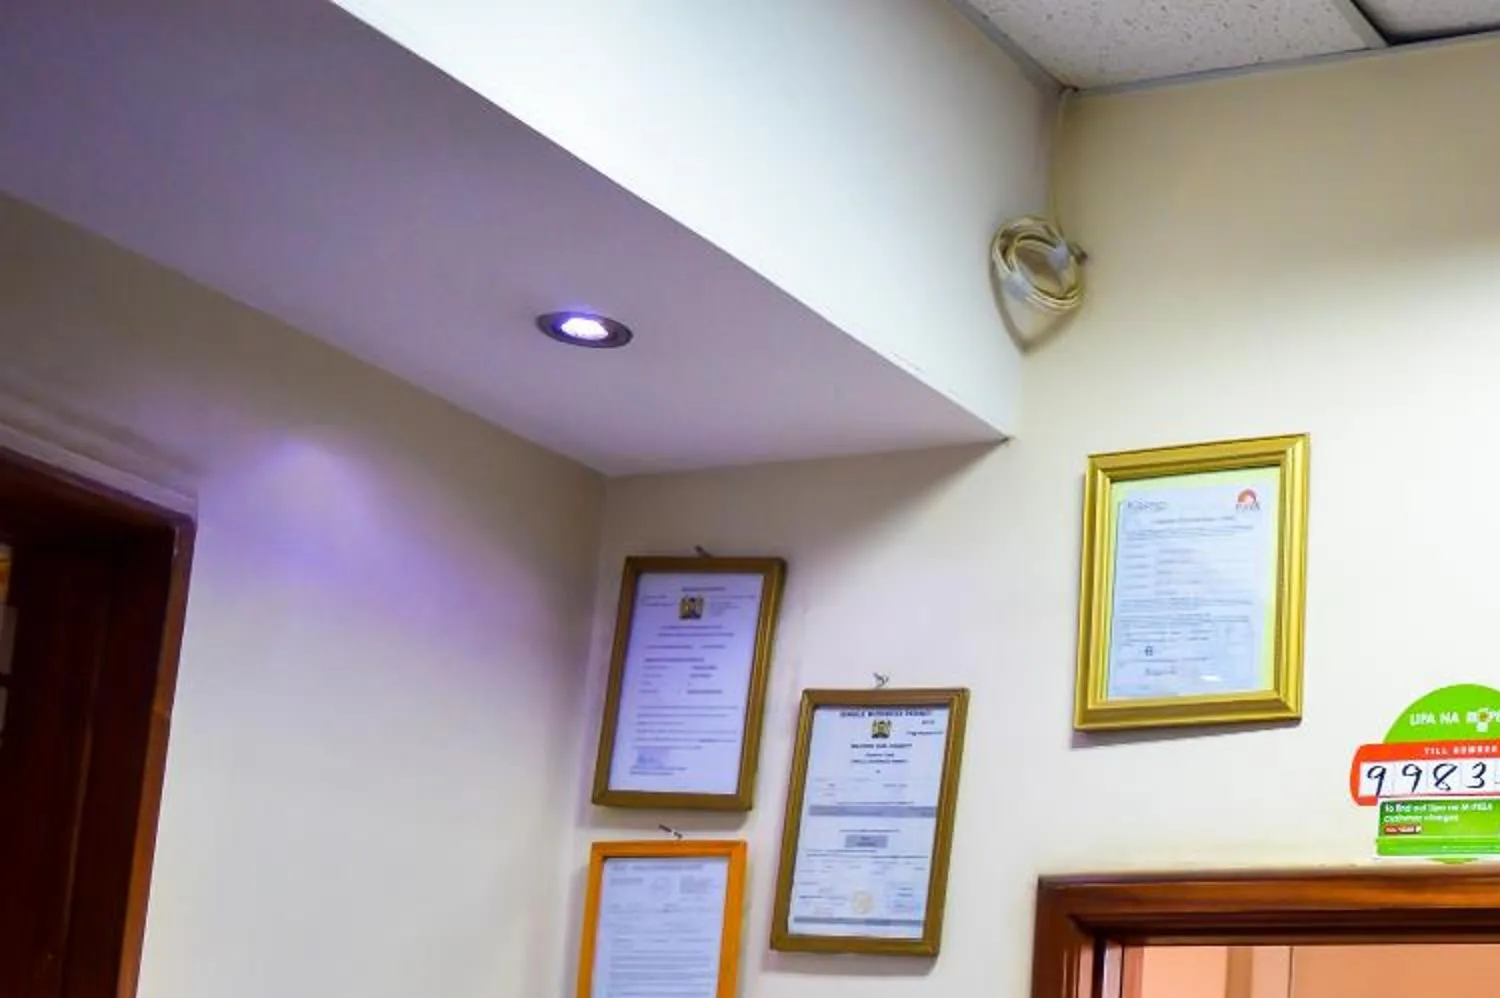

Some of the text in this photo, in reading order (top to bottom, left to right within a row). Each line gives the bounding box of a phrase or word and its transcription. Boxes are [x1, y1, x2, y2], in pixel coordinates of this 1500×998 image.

[1409, 711, 1437, 727] LIPA
[1439, 710, 1460, 725] NA
[1424, 746, 1448, 755] TILL
